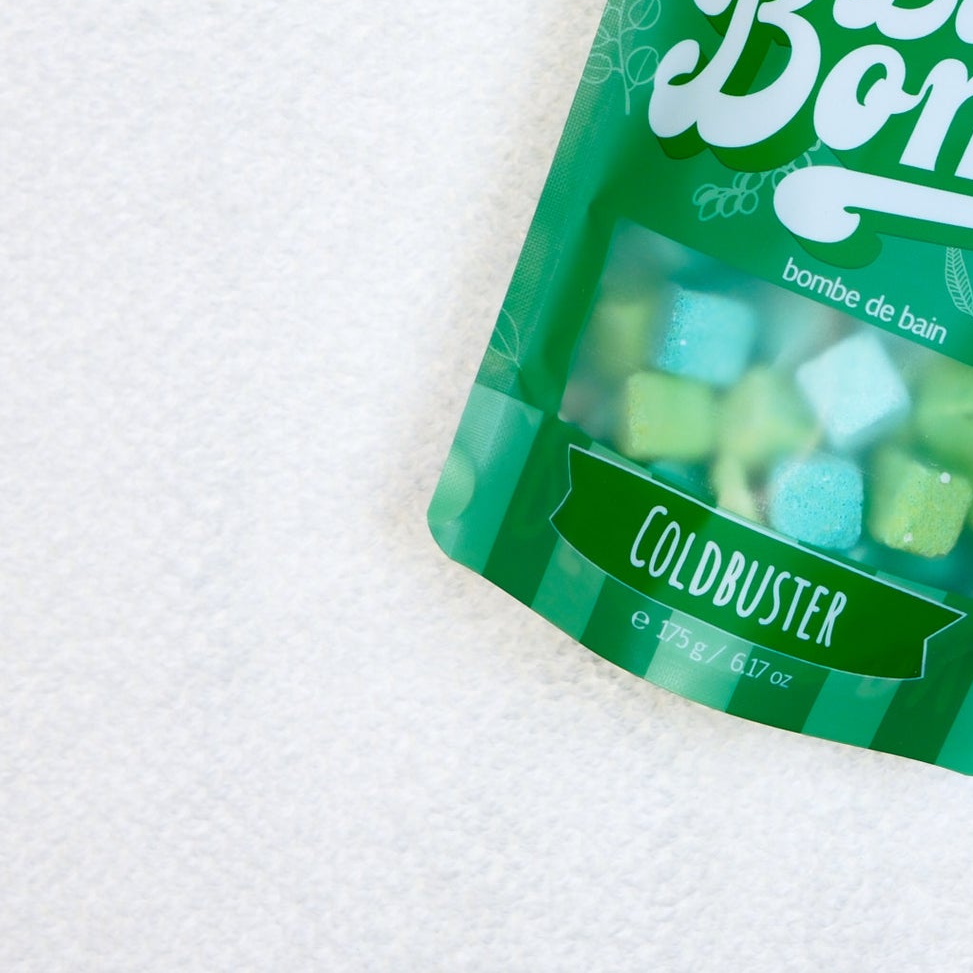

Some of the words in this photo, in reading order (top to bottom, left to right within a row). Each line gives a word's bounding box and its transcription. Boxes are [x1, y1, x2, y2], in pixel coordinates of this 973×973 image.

[781, 257, 860, 309] bombe
[864, 294, 895, 323] de
[898, 305, 948, 345] bain
[630, 505, 848, 647] COLDBUSTER
[730, 652, 770, 679] 6.17
[770, 670, 793, 688] oz
